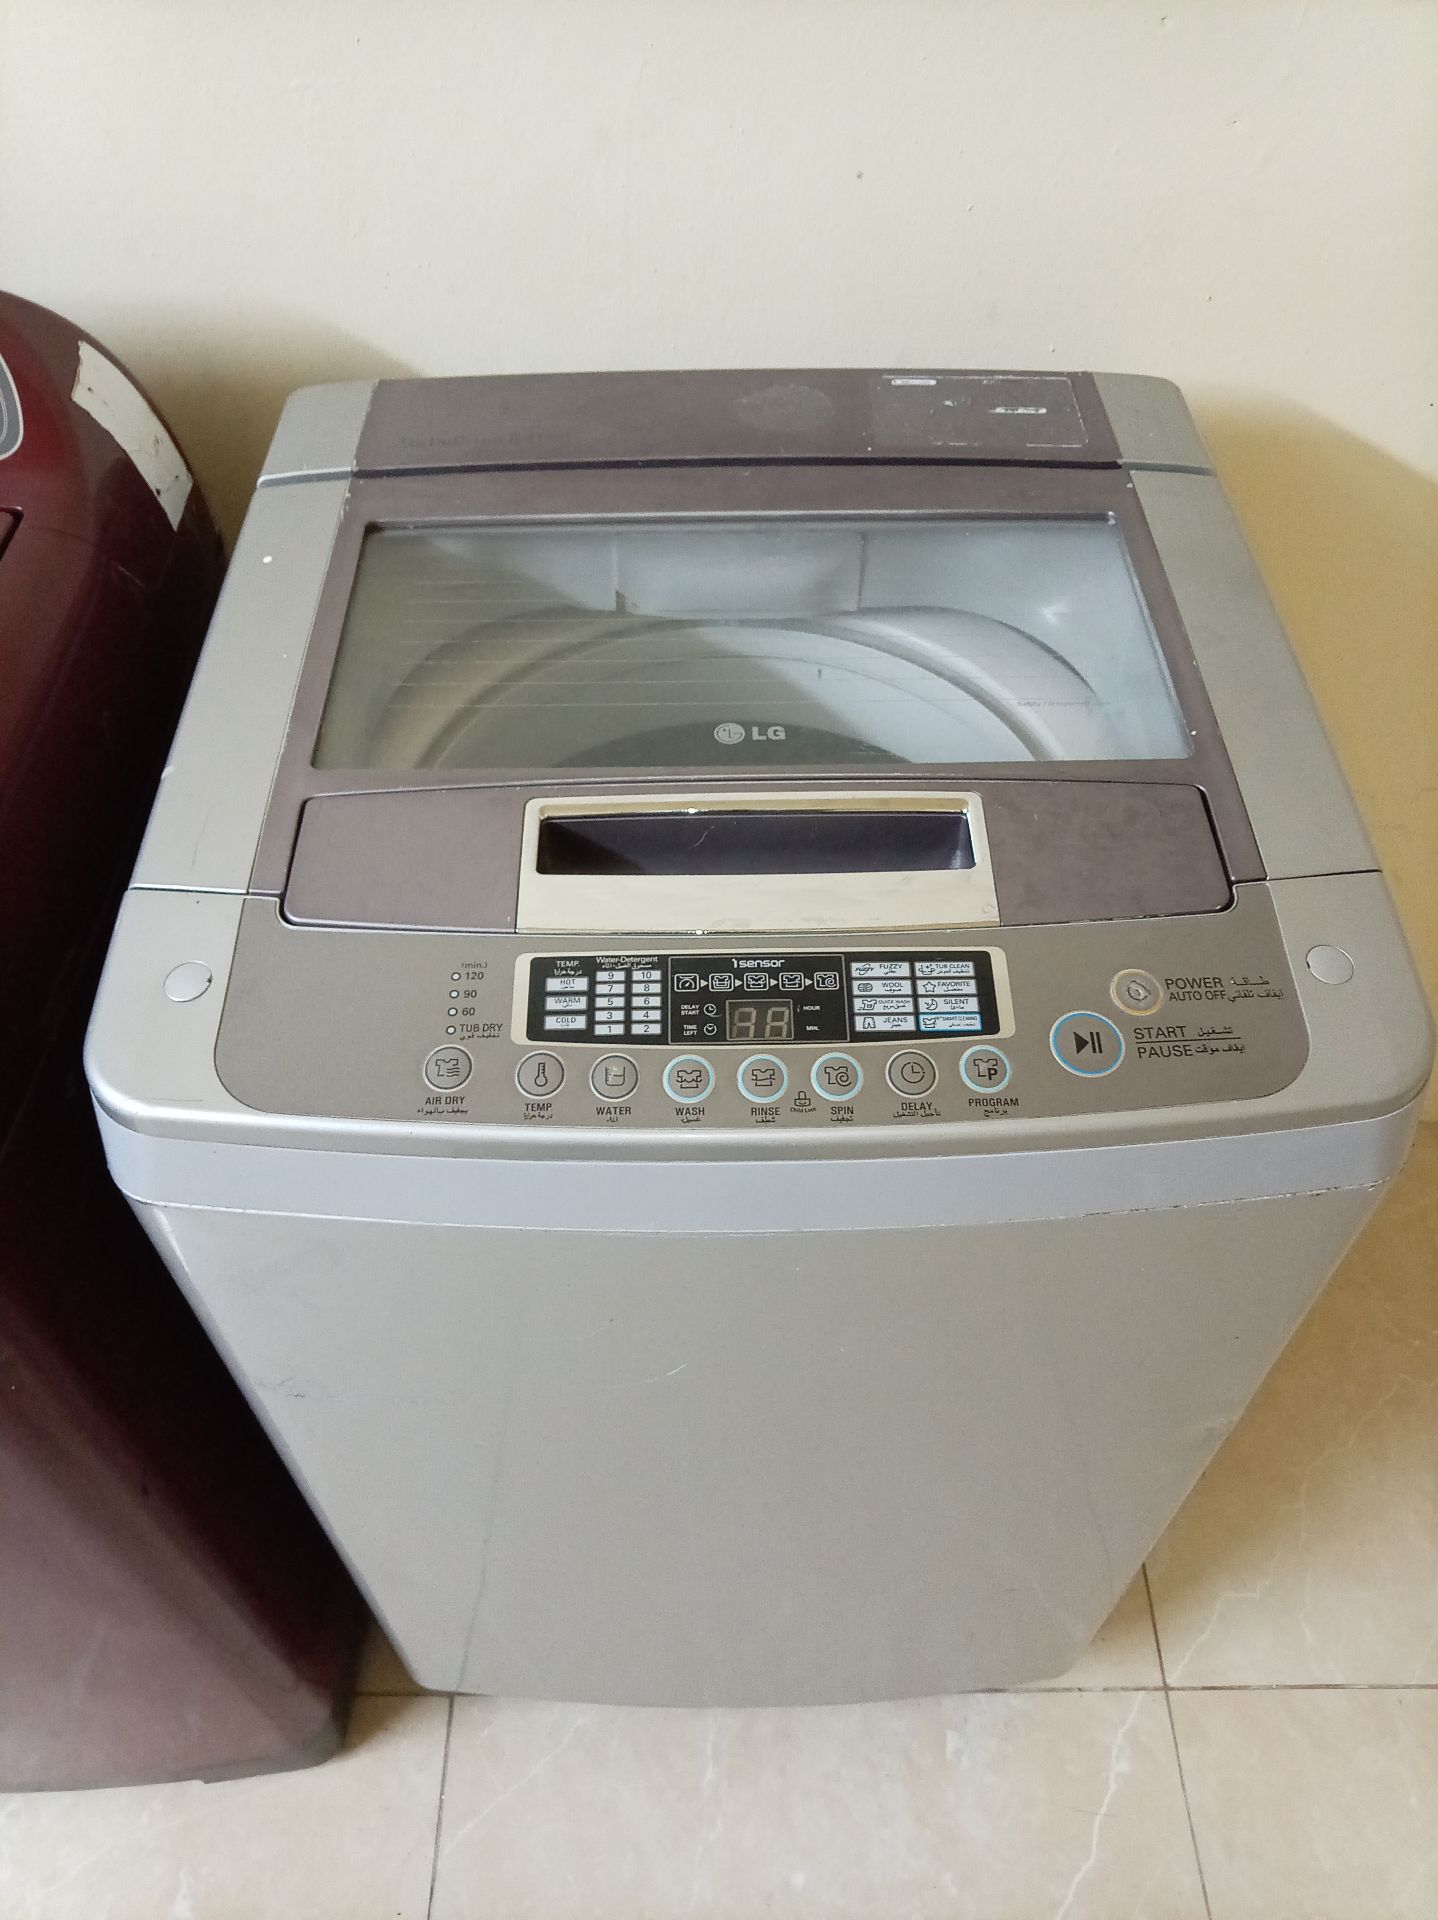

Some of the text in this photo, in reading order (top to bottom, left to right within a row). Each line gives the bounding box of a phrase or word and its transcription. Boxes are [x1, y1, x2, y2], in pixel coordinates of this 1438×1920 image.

[752, 726, 786, 740] LG
[465, 972, 484, 980] 120
[643, 984, 650, 992] 8
[1164, 977, 1224, 990] POWER
[463, 990, 477, 998] 90
[1169, 989, 1227, 1001] AUTO OFF
[607, 998, 613, 1006] 5
[462, 1007, 475, 1016] 60
[606, 1011, 613, 1020] 3
[643, 1011, 649, 1019] 4
[460, 1023, 503, 1032] TUB DRY
[643, 1025, 650, 1033] 2
[1133, 1026, 1187, 1040] START
[1137, 1044, 1194, 1059] PAUSE
[424, 1096, 466, 1105] AIR DRY
[968, 1098, 1020, 1107] PROGRAM
[596, 1106, 632, 1115] WATER
[830, 1106, 854, 1115] SPIN
[901, 1101, 932, 1111] DELAY
[675, 1107, 705, 1116] WASH
[751, 1107, 780, 1116] RINSE
